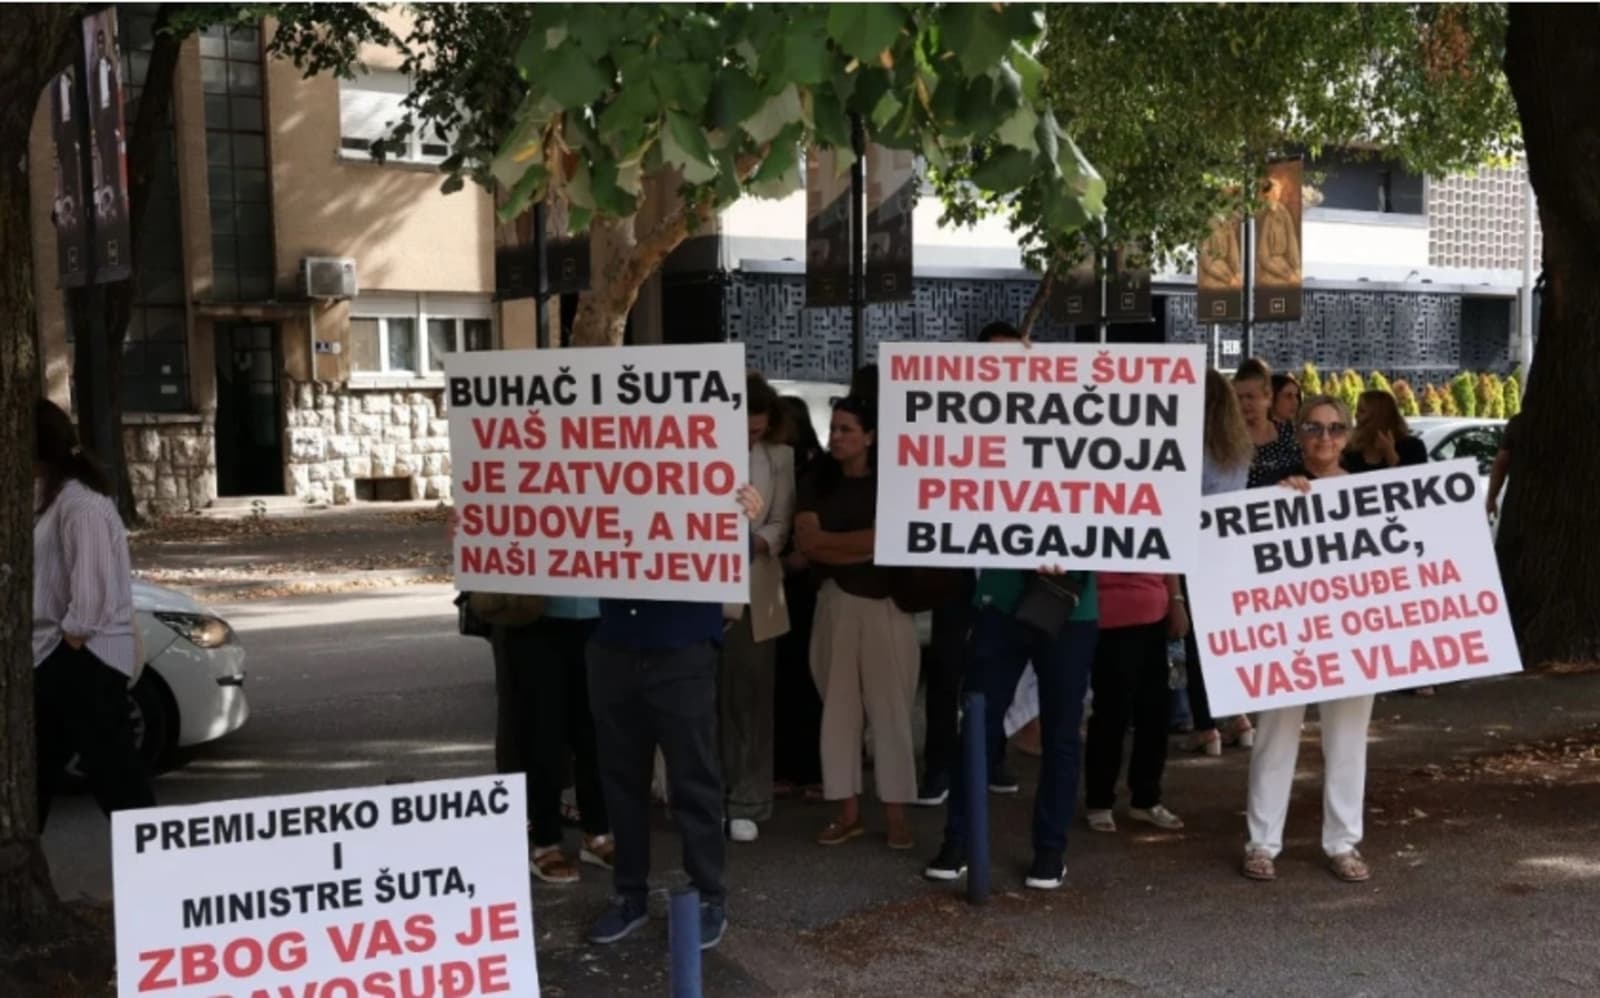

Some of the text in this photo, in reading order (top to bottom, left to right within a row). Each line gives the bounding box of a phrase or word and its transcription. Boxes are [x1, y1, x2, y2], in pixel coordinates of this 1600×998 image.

[450, 364, 743, 410] BUHAČ I ŠUTA,
[890, 350, 1197, 385] MINISTRE ŠUTA
[905, 384, 1179, 427] PRORAČUN
[471, 409, 718, 450] VAŠ NEMAR
[897, 434, 1187, 472] NIJE TVOJA
[462, 460, 736, 496] JE ZATVORIO
[917, 478, 1163, 516] PRIVATNA
[462, 504, 739, 547] SUDOVE, A NE
[907, 521, 1171, 560] BLAGAJNA
[1253, 515, 1424, 574] BUHAČ,
[460, 541, 742, 583] NAŠI ZAHTJEVI!
[1232, 558, 1462, 616] PRAVOSUĐE NA
[1207, 590, 1499, 657] ULICI JE OGLEDALO
[1236, 630, 1489, 698] VAŠE VLADE
[134, 781, 510, 853] PREMIJERKO BUHAČ
[333, 842, 342, 869] I
[182, 866, 476, 928] MINISTRE ŠUTA,
[138, 902, 520, 992] ZBOG VAS JE
